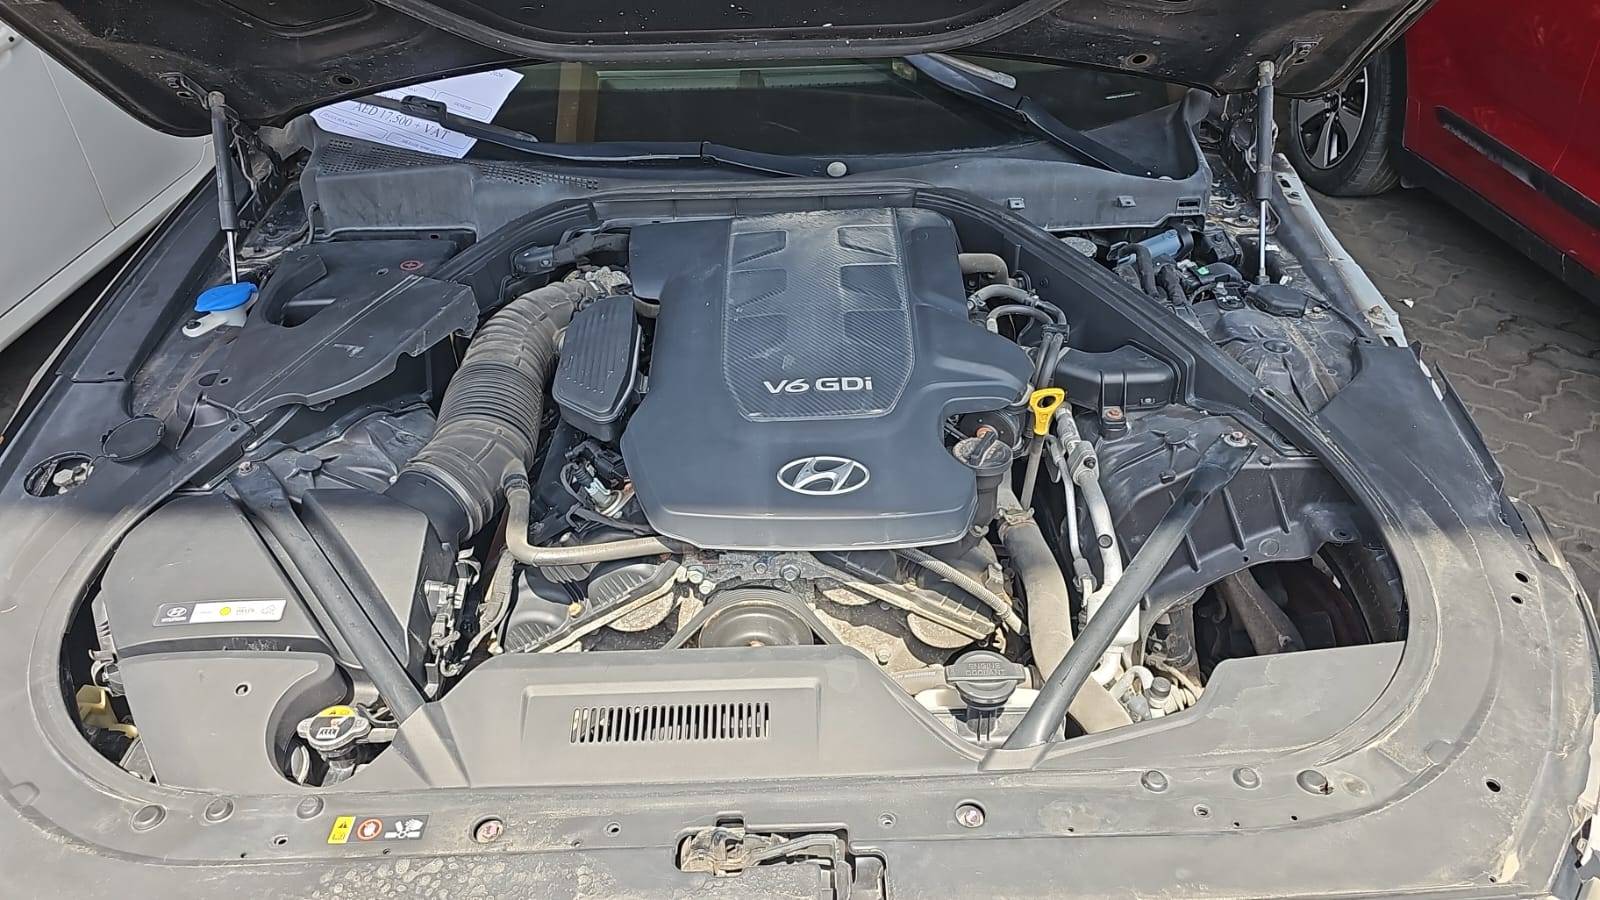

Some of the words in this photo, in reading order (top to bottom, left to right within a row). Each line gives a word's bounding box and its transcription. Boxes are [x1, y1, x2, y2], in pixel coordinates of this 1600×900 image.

[352, 103, 379, 116] AED
[380, 109, 412, 128] 17,500
[424, 125, 451, 141] VAT
[763, 379, 810, 394] V6
[815, 376, 873, 391] GDi
[968, 662, 1001, 670] ENGINE
[965, 669, 1005, 677] COOLANT
